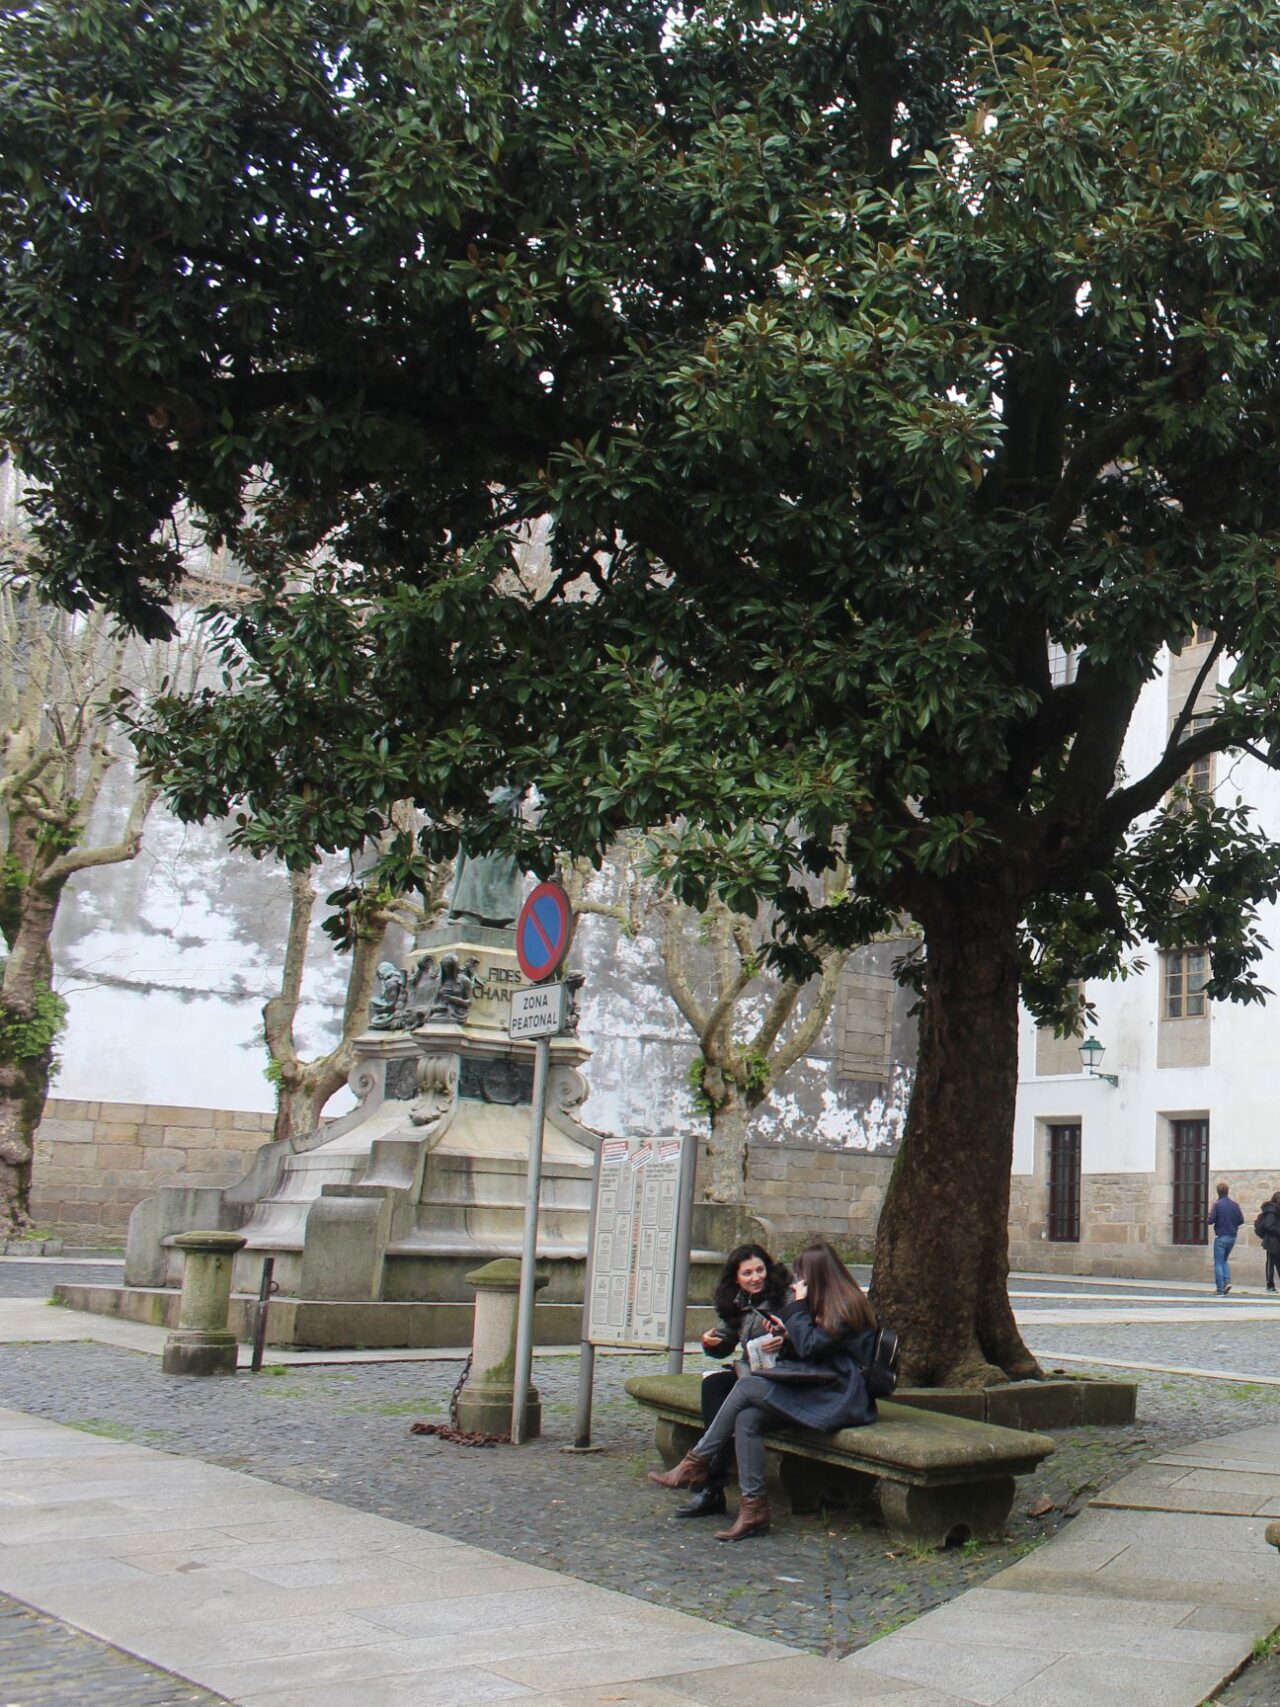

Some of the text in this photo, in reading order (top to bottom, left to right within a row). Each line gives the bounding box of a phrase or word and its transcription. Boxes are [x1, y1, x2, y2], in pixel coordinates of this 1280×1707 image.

[488, 967, 521, 983] FIDES
[523, 994, 548, 1011] ZONA
[512, 1012, 557, 1031] PEATONAL
